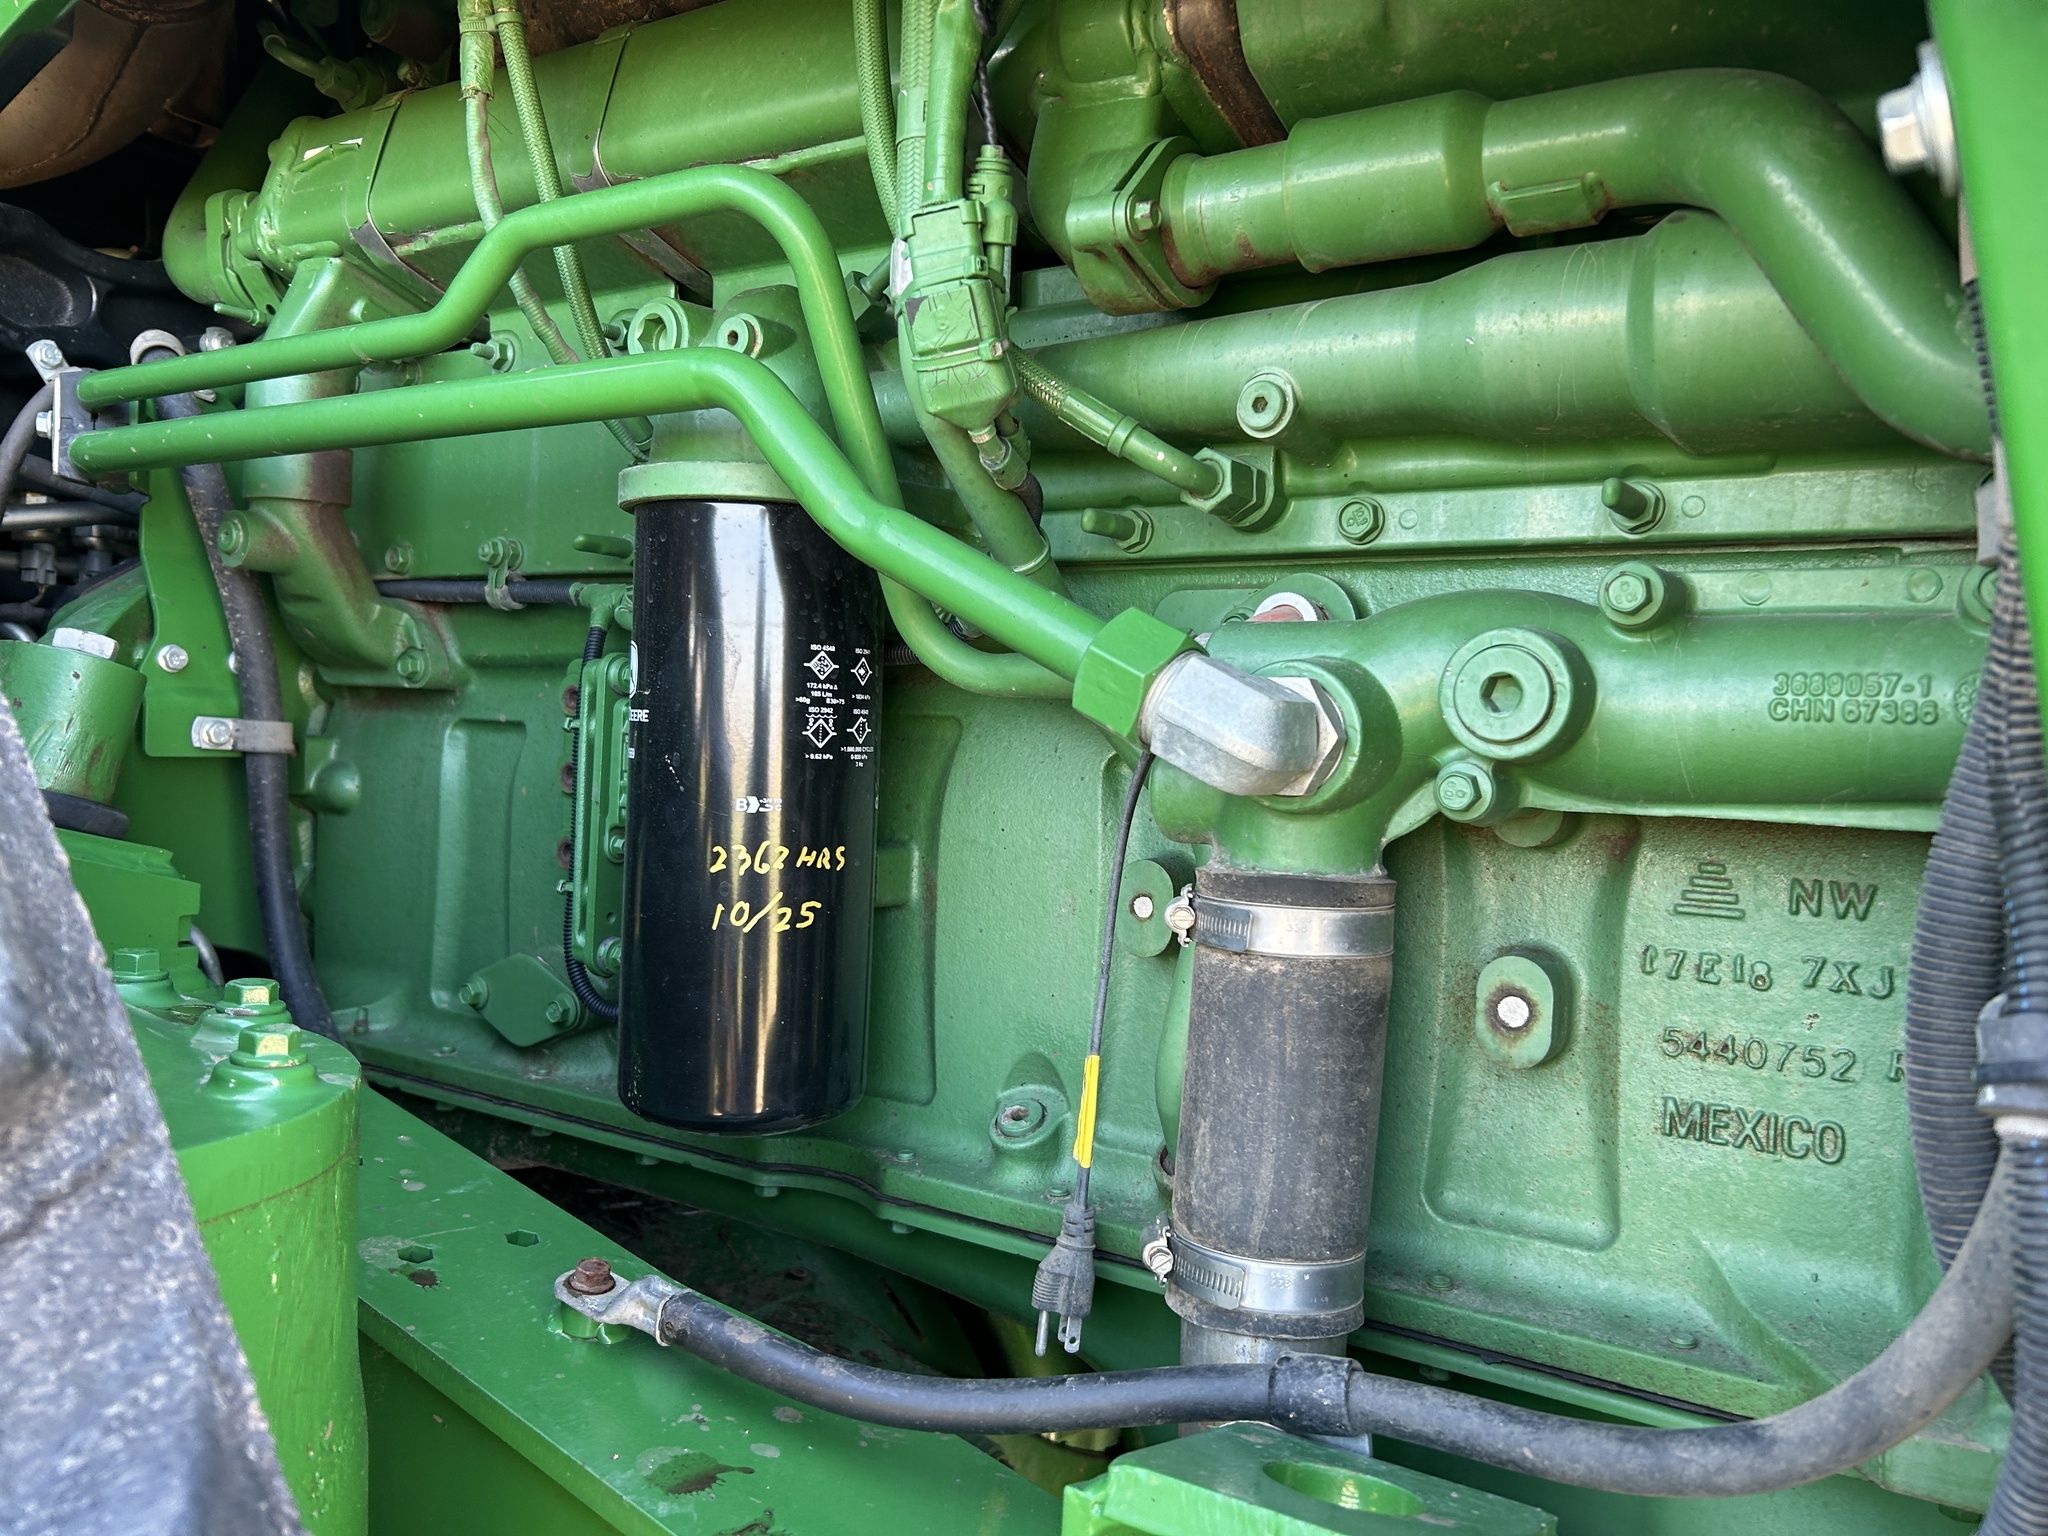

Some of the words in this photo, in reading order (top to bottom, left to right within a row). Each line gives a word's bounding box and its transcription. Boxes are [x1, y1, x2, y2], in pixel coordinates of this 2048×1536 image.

[1773, 672, 1932, 698] 3689057-1
[629, 707, 650, 722] EERE
[1768, 697, 1835, 723] CHN
[709, 840, 790, 876] 2362
[796, 846, 846, 871] HRS
[711, 892, 823, 933] 10/25
[1788, 877, 1878, 922] NW
[1801, 954, 1896, 1000] 7XJ
[1661, 1026, 1857, 1082] 5440752
[1661, 1096, 1846, 1165] MEXICO
